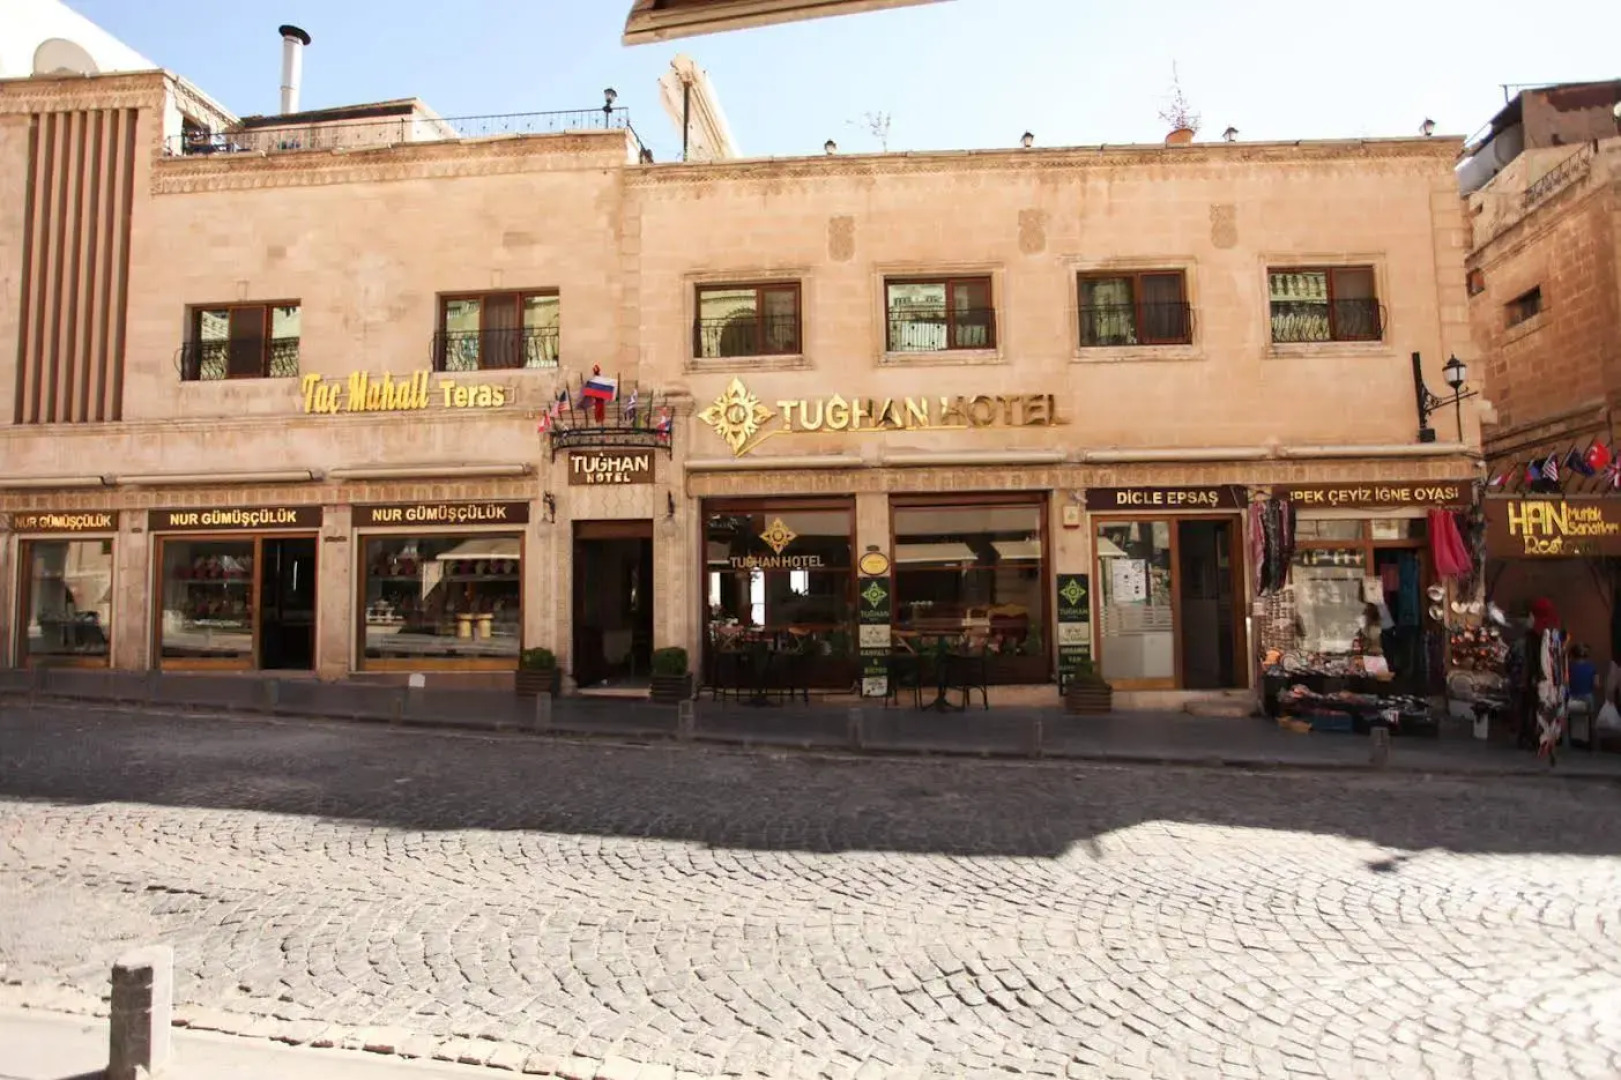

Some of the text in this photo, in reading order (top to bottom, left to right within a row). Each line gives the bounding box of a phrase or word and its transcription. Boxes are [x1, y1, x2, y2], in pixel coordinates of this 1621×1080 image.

[347, 370, 430, 412] Mahall
[440, 379, 505, 408] Teras
[938, 394, 1072, 426] HOTEL
[586, 472, 631, 483] HOTEL
[1116, 489, 1219, 508] DİCLE EPSAŞ
[1328, 487, 1372, 505] ÇEYİZ
[170, 508, 297, 527] NUR GÜMÜŞÇÜLÜK
[372, 504, 507, 522] NUR GÜMÜŞÇÜLÜK
[1507, 500, 1569, 536] HAN
[15, 516, 37, 529] NUR
[782, 554, 825, 567] HOTEL
